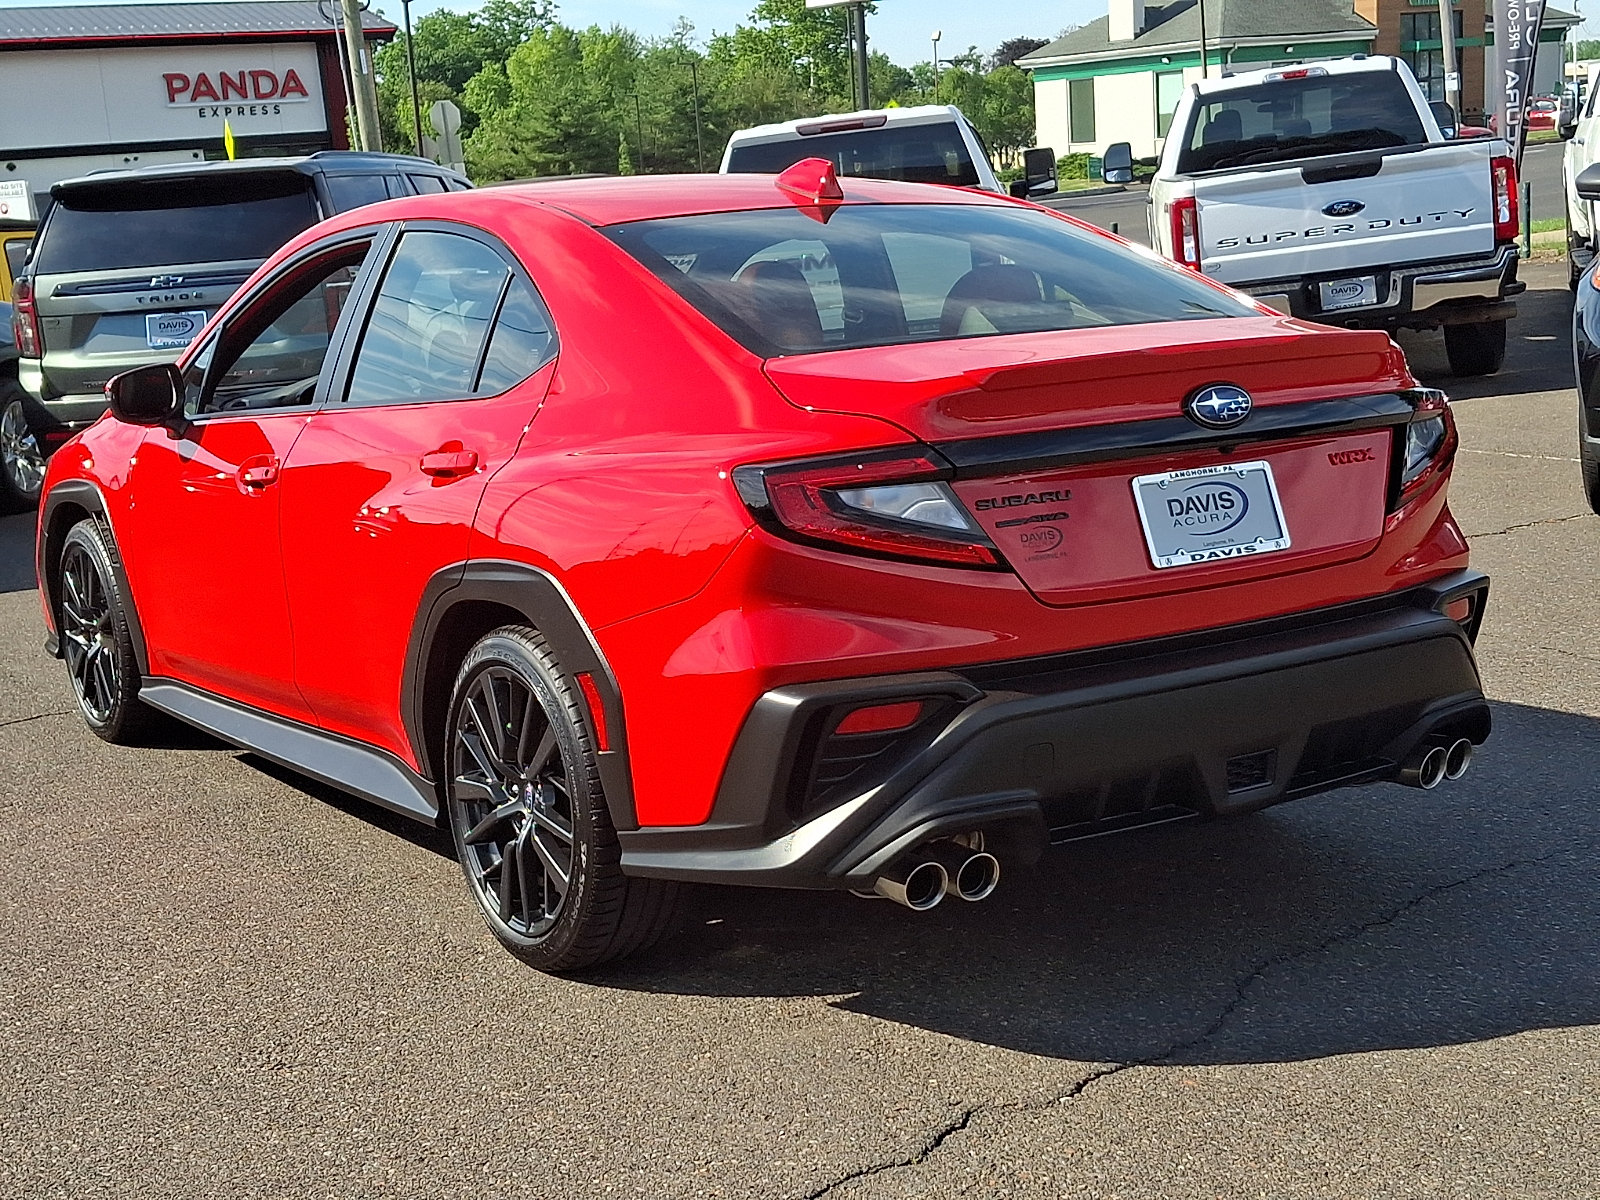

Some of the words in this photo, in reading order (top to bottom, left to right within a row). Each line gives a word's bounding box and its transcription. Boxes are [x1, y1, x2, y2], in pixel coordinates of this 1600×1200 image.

[162, 68, 309, 103] PANDA
[198, 104, 281, 118] EXPRESS
[1216, 223, 1356, 249] SUPER
[1368, 207, 1476, 230] DUTY
[136, 291, 204, 304] TAHOE
[1331, 285, 1359, 296] DAVIS
[158, 320, 189, 331] DAVIS
[1327, 447, 1376, 466] WRX
[974, 489, 1072, 511] SUBARU
[1166, 491, 1235, 518] DAVIS
[1173, 511, 1233, 528] ACURA
[1020, 530, 1056, 543] DAVIS
[1190, 545, 1258, 562] DAVIS
